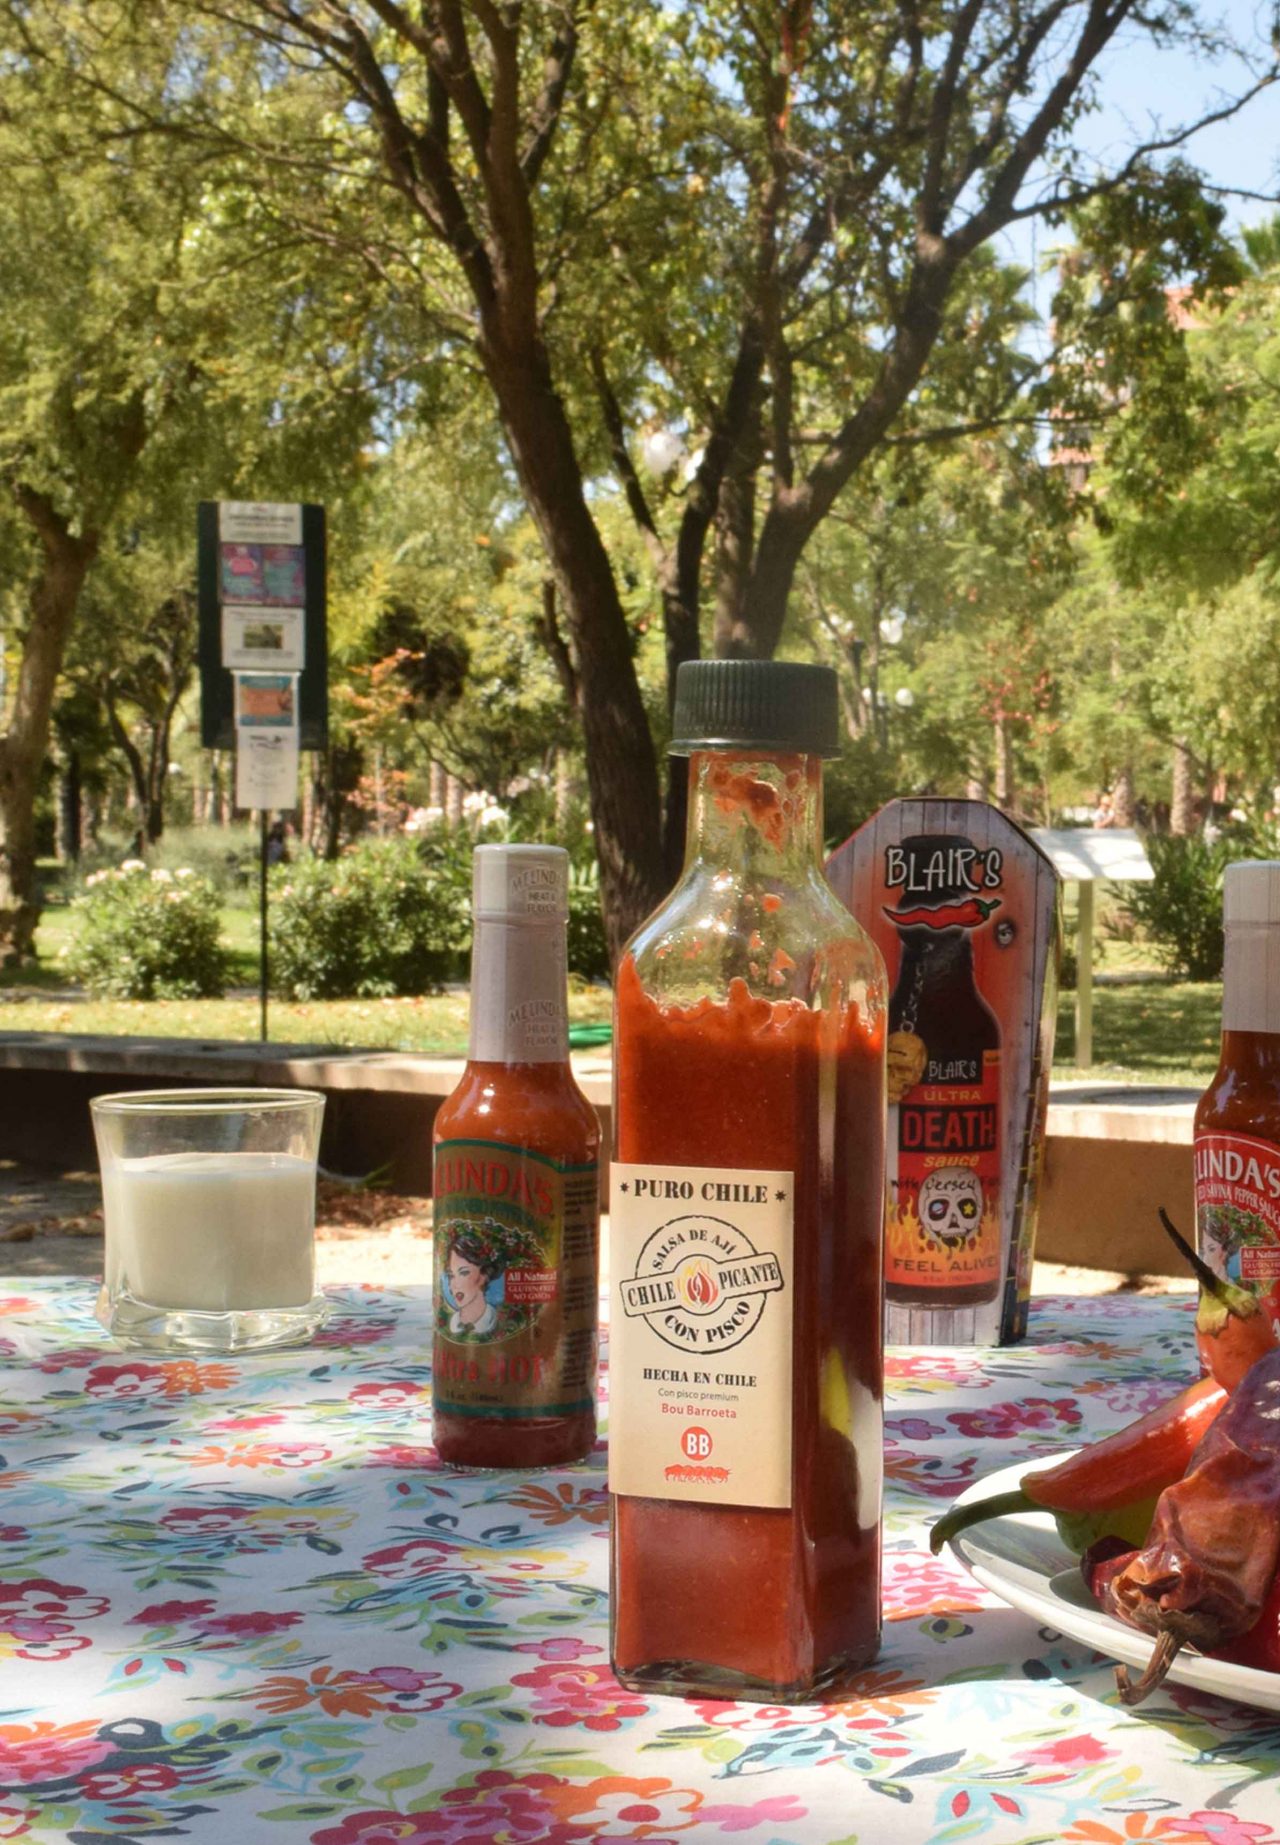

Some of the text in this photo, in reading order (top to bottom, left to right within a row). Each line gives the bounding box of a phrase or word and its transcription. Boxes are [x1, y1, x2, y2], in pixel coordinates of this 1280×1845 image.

[512, 868, 560, 888] MELIND
[887, 848, 1001, 891] BLAIR'S
[924, 1090, 981, 1101] ULTRA
[903, 1110, 994, 1147] DEATH
[634, 1178, 769, 1204] PURO CHILE
[1234, 1187, 1258, 1209] PEPPER
[652, 1230, 686, 1271] SALSA
[689, 1229, 708, 1242] DE
[508, 1270, 557, 1281] All Natural
[893, 1257, 942, 1272] FEEL
[627, 1280, 677, 1308] CHILE
[718, 1262, 779, 1291] PICANTE
[664, 1300, 750, 1343] CON PISCO
[487, 1352, 543, 1388] HOT
[643, 1367, 757, 1388] HECHA EN CHILE
[658, 1387, 739, 1404] Con pisco premium
[661, 1402, 737, 1419] Bou Barroeta
[686, 1432, 710, 1456] BB
